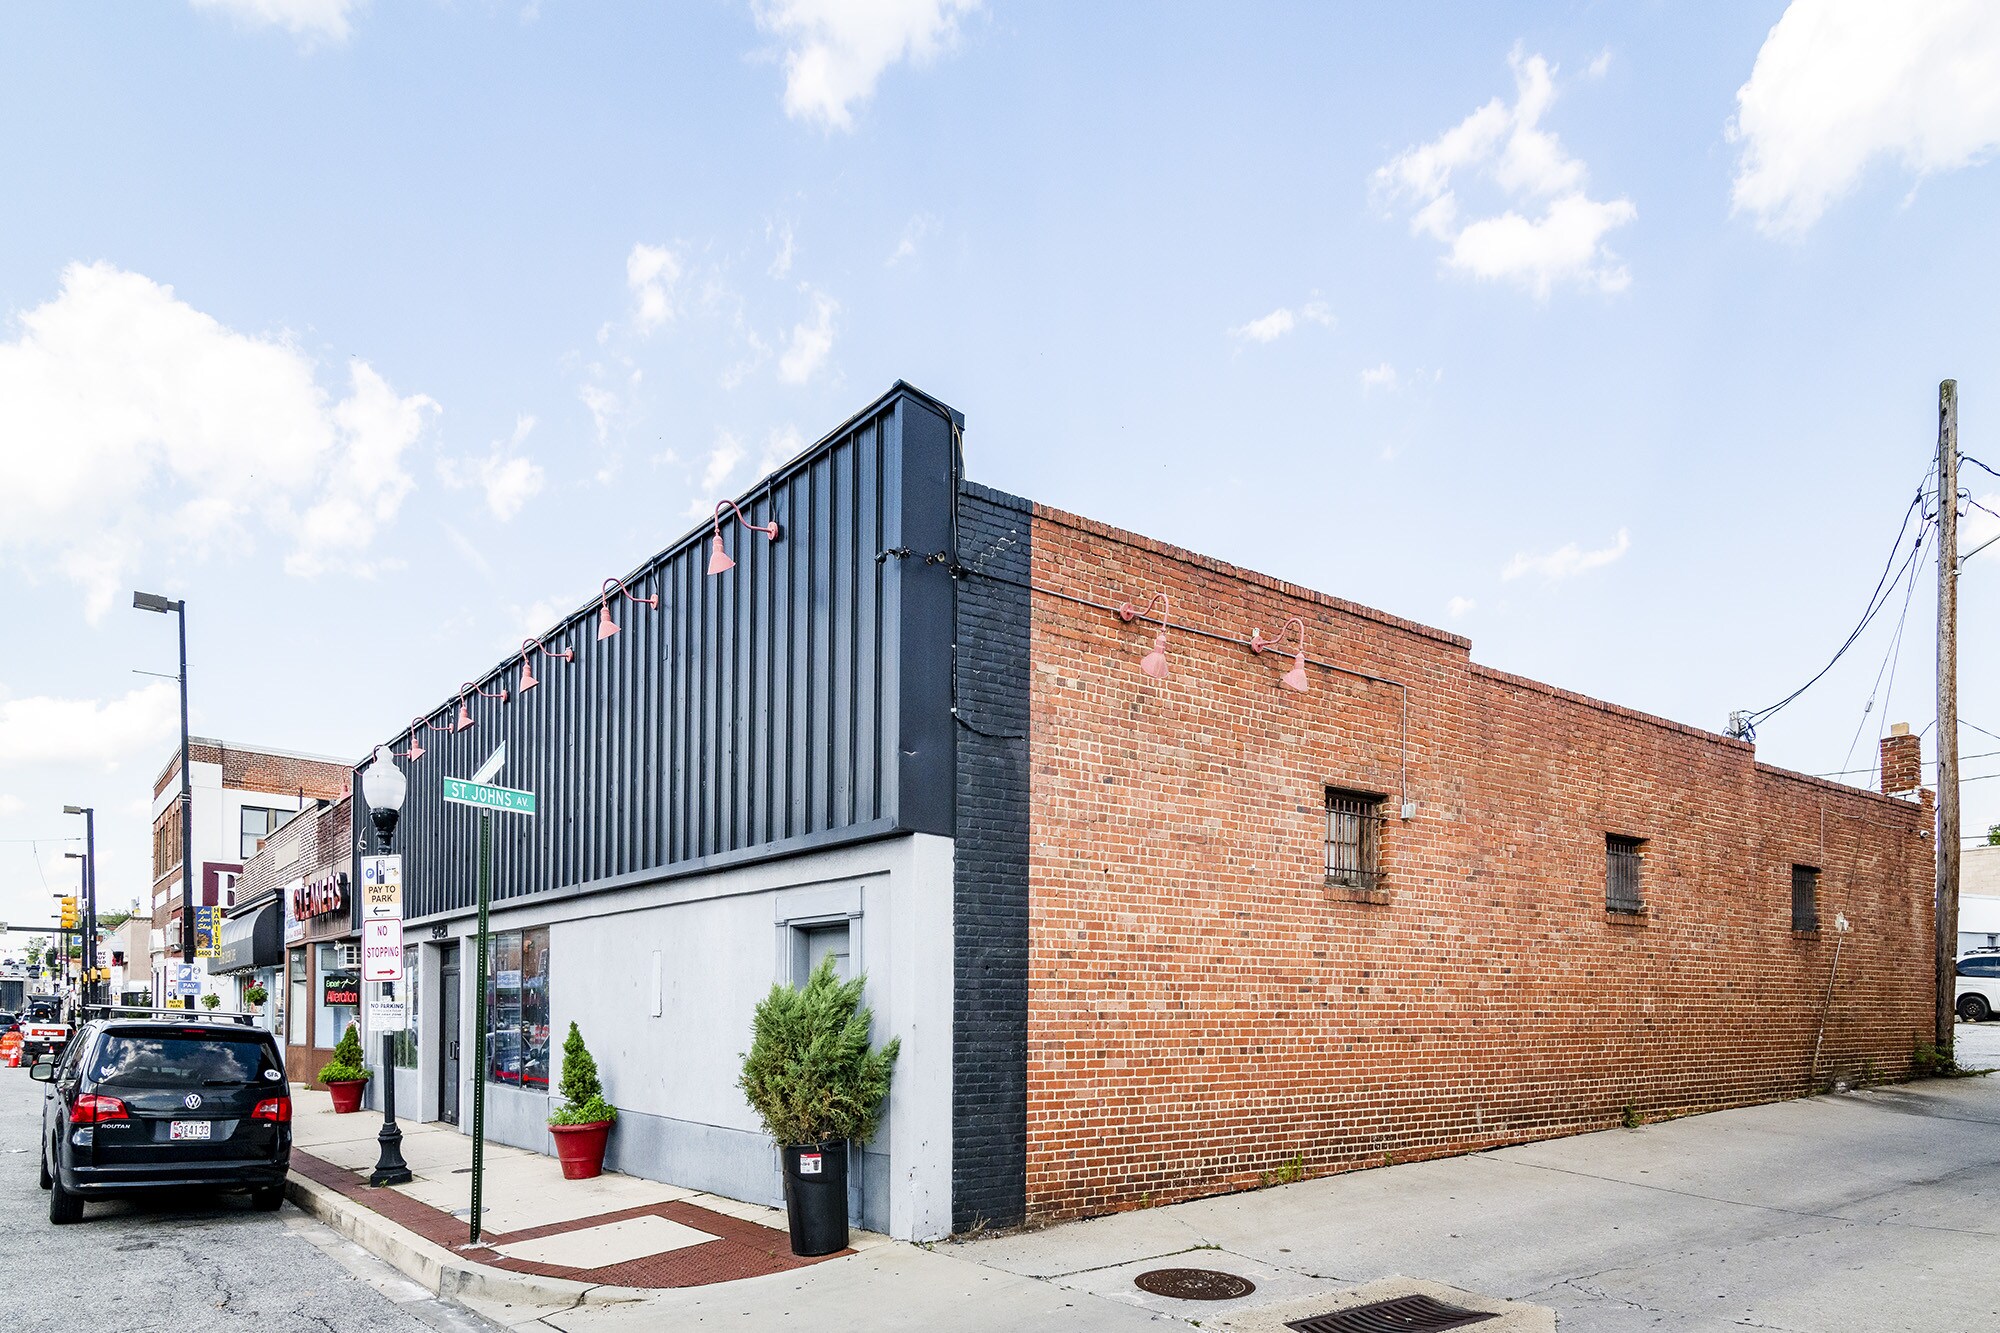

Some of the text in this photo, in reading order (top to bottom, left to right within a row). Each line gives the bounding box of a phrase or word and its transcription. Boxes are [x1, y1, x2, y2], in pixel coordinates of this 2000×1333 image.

[451, 782, 529, 807] ST. JOHNS AV.
[368, 885, 396, 894] PAY TO
[293, 872, 342, 922] CLEANERS
[371, 894, 393, 903] PARK
[213, 907, 221, 956] HAMILTON
[376, 925, 388, 937] NO
[366, 946, 400, 959] STOPPING
